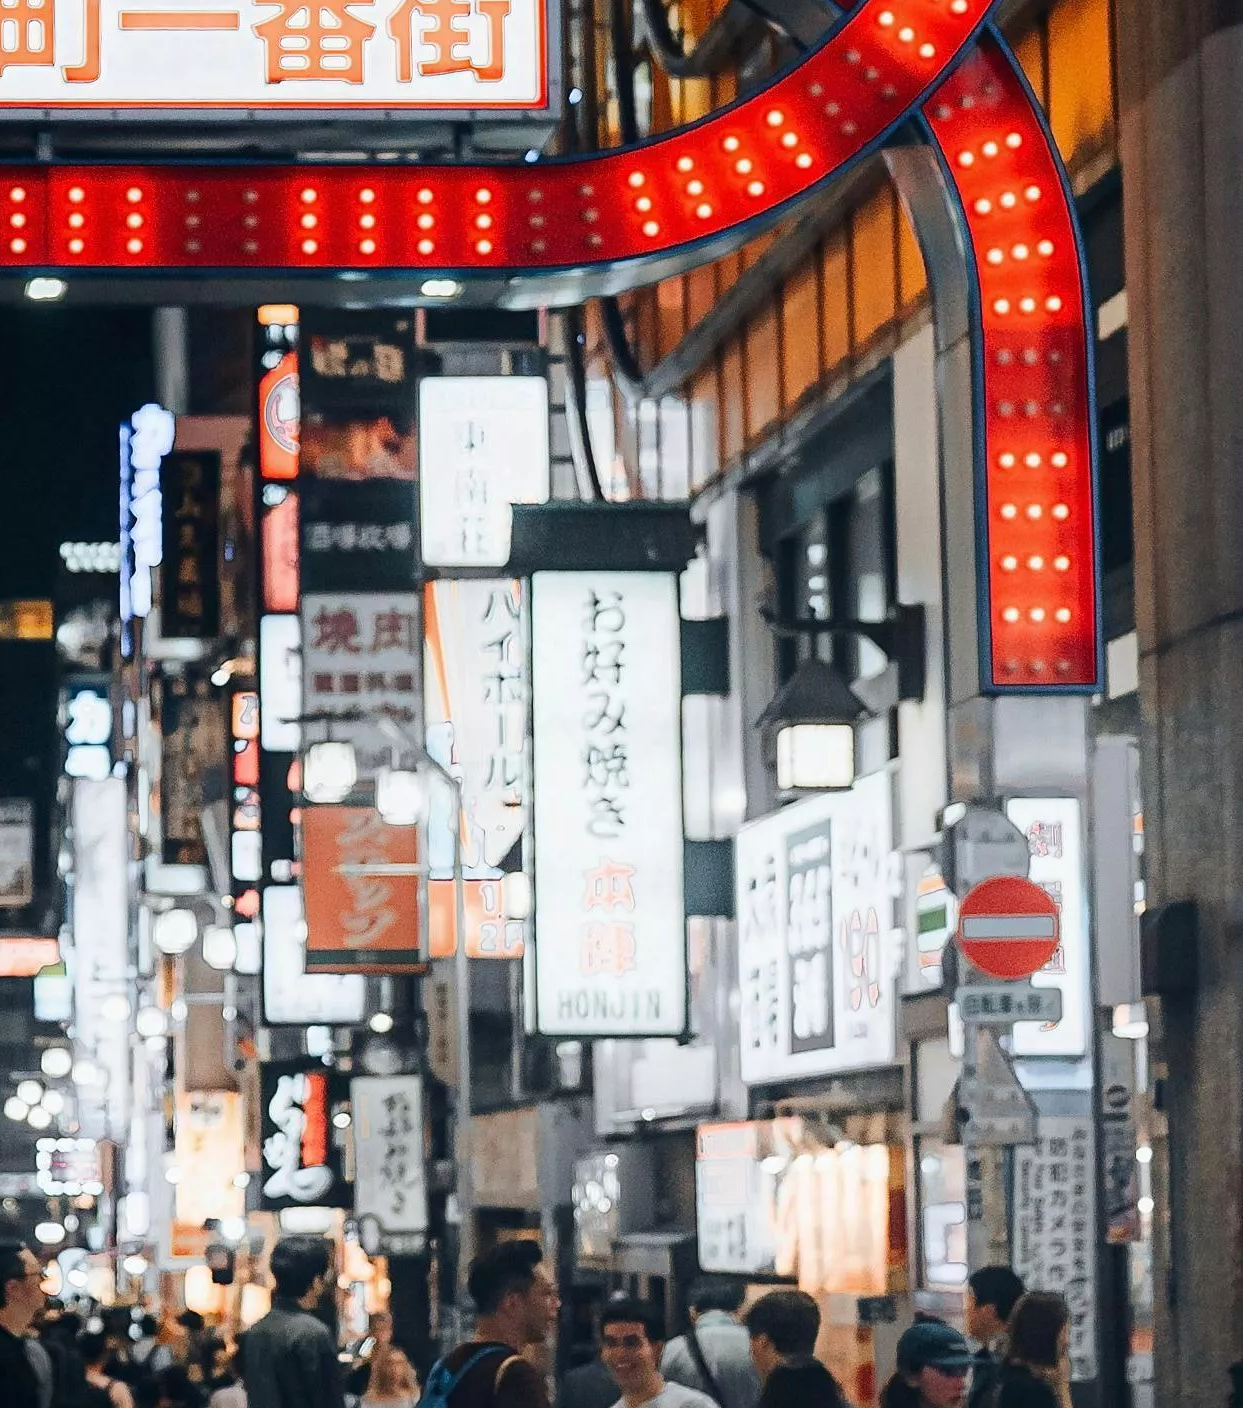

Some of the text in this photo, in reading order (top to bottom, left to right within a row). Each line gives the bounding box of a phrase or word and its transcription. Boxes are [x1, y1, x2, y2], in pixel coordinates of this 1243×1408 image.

[582, 588, 632, 840] お好み焼き
[557, 990, 662, 1021] HONJIN
